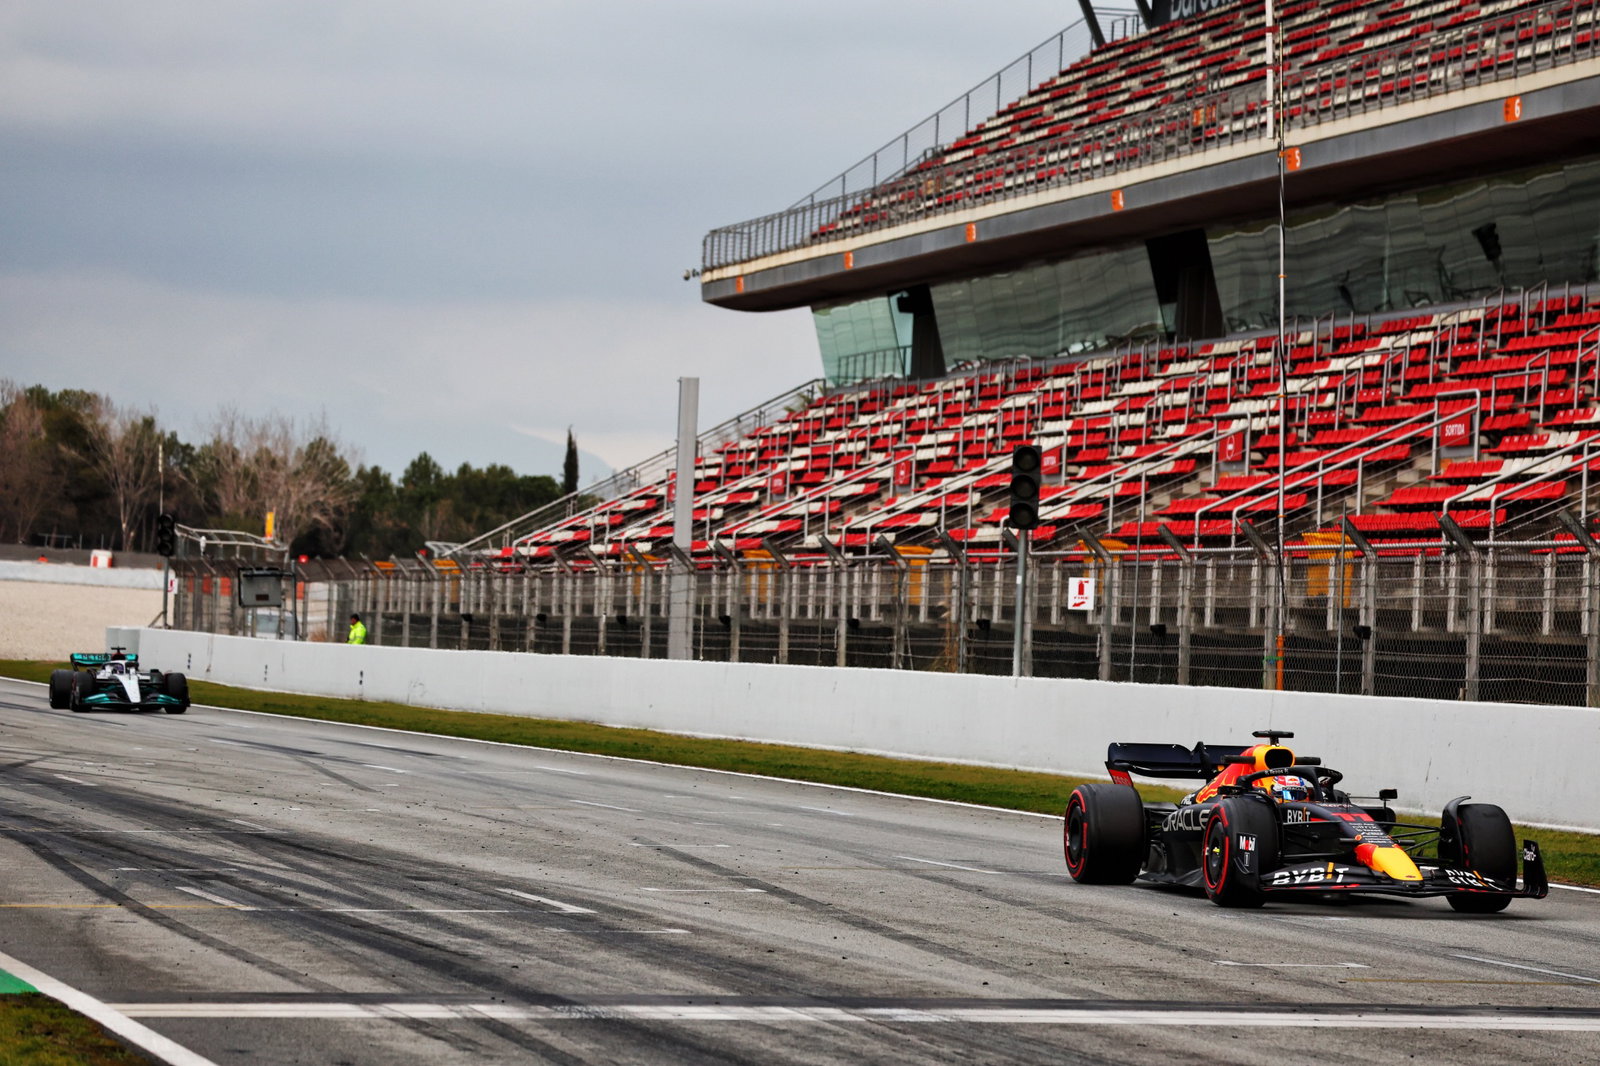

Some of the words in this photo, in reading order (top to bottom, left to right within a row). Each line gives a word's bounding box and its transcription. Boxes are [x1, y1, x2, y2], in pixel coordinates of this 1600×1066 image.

[1445, 423, 1465, 437] SORTIDA
[1161, 809, 1211, 832] ORACLE
[1287, 806, 1311, 823] BYBIT
[1331, 813, 1375, 822] 11
[1239, 835, 1256, 852] Mobil
[1272, 861, 1349, 885] BYBIT
